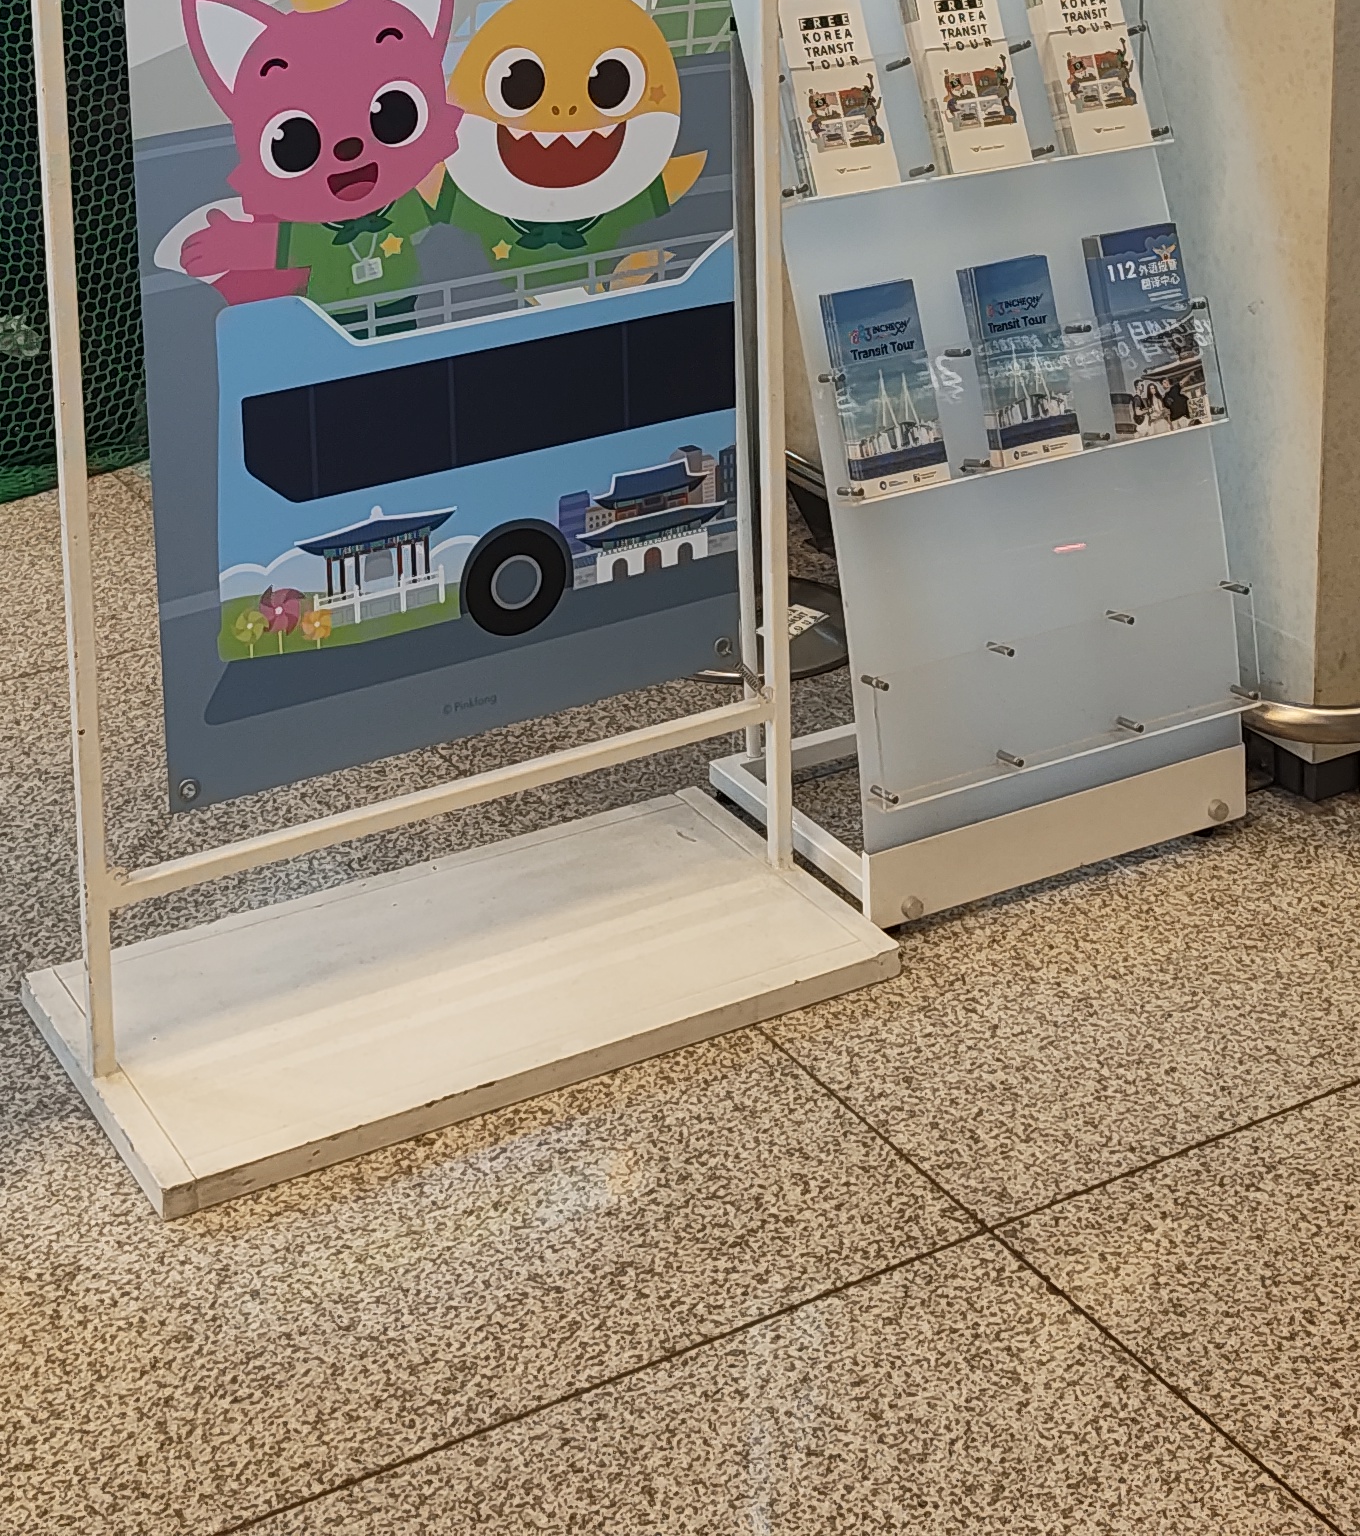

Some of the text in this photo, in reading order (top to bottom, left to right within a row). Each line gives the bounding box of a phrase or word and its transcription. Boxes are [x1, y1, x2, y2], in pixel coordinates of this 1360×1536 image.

[799, 13, 850, 31] FREE
[938, 10, 987, 26] KOREA
[1062, 8, 1108, 22] TRANSIT
[802, 29, 853, 44] KOREA
[940, 24, 988, 39] TRANSIT
[805, 41, 855, 57] TRANSIT
[1107, 261, 1137, 283] 112
[988, 315, 1047, 333] Transit Tour
[850, 340, 915, 361] Transit Tour
